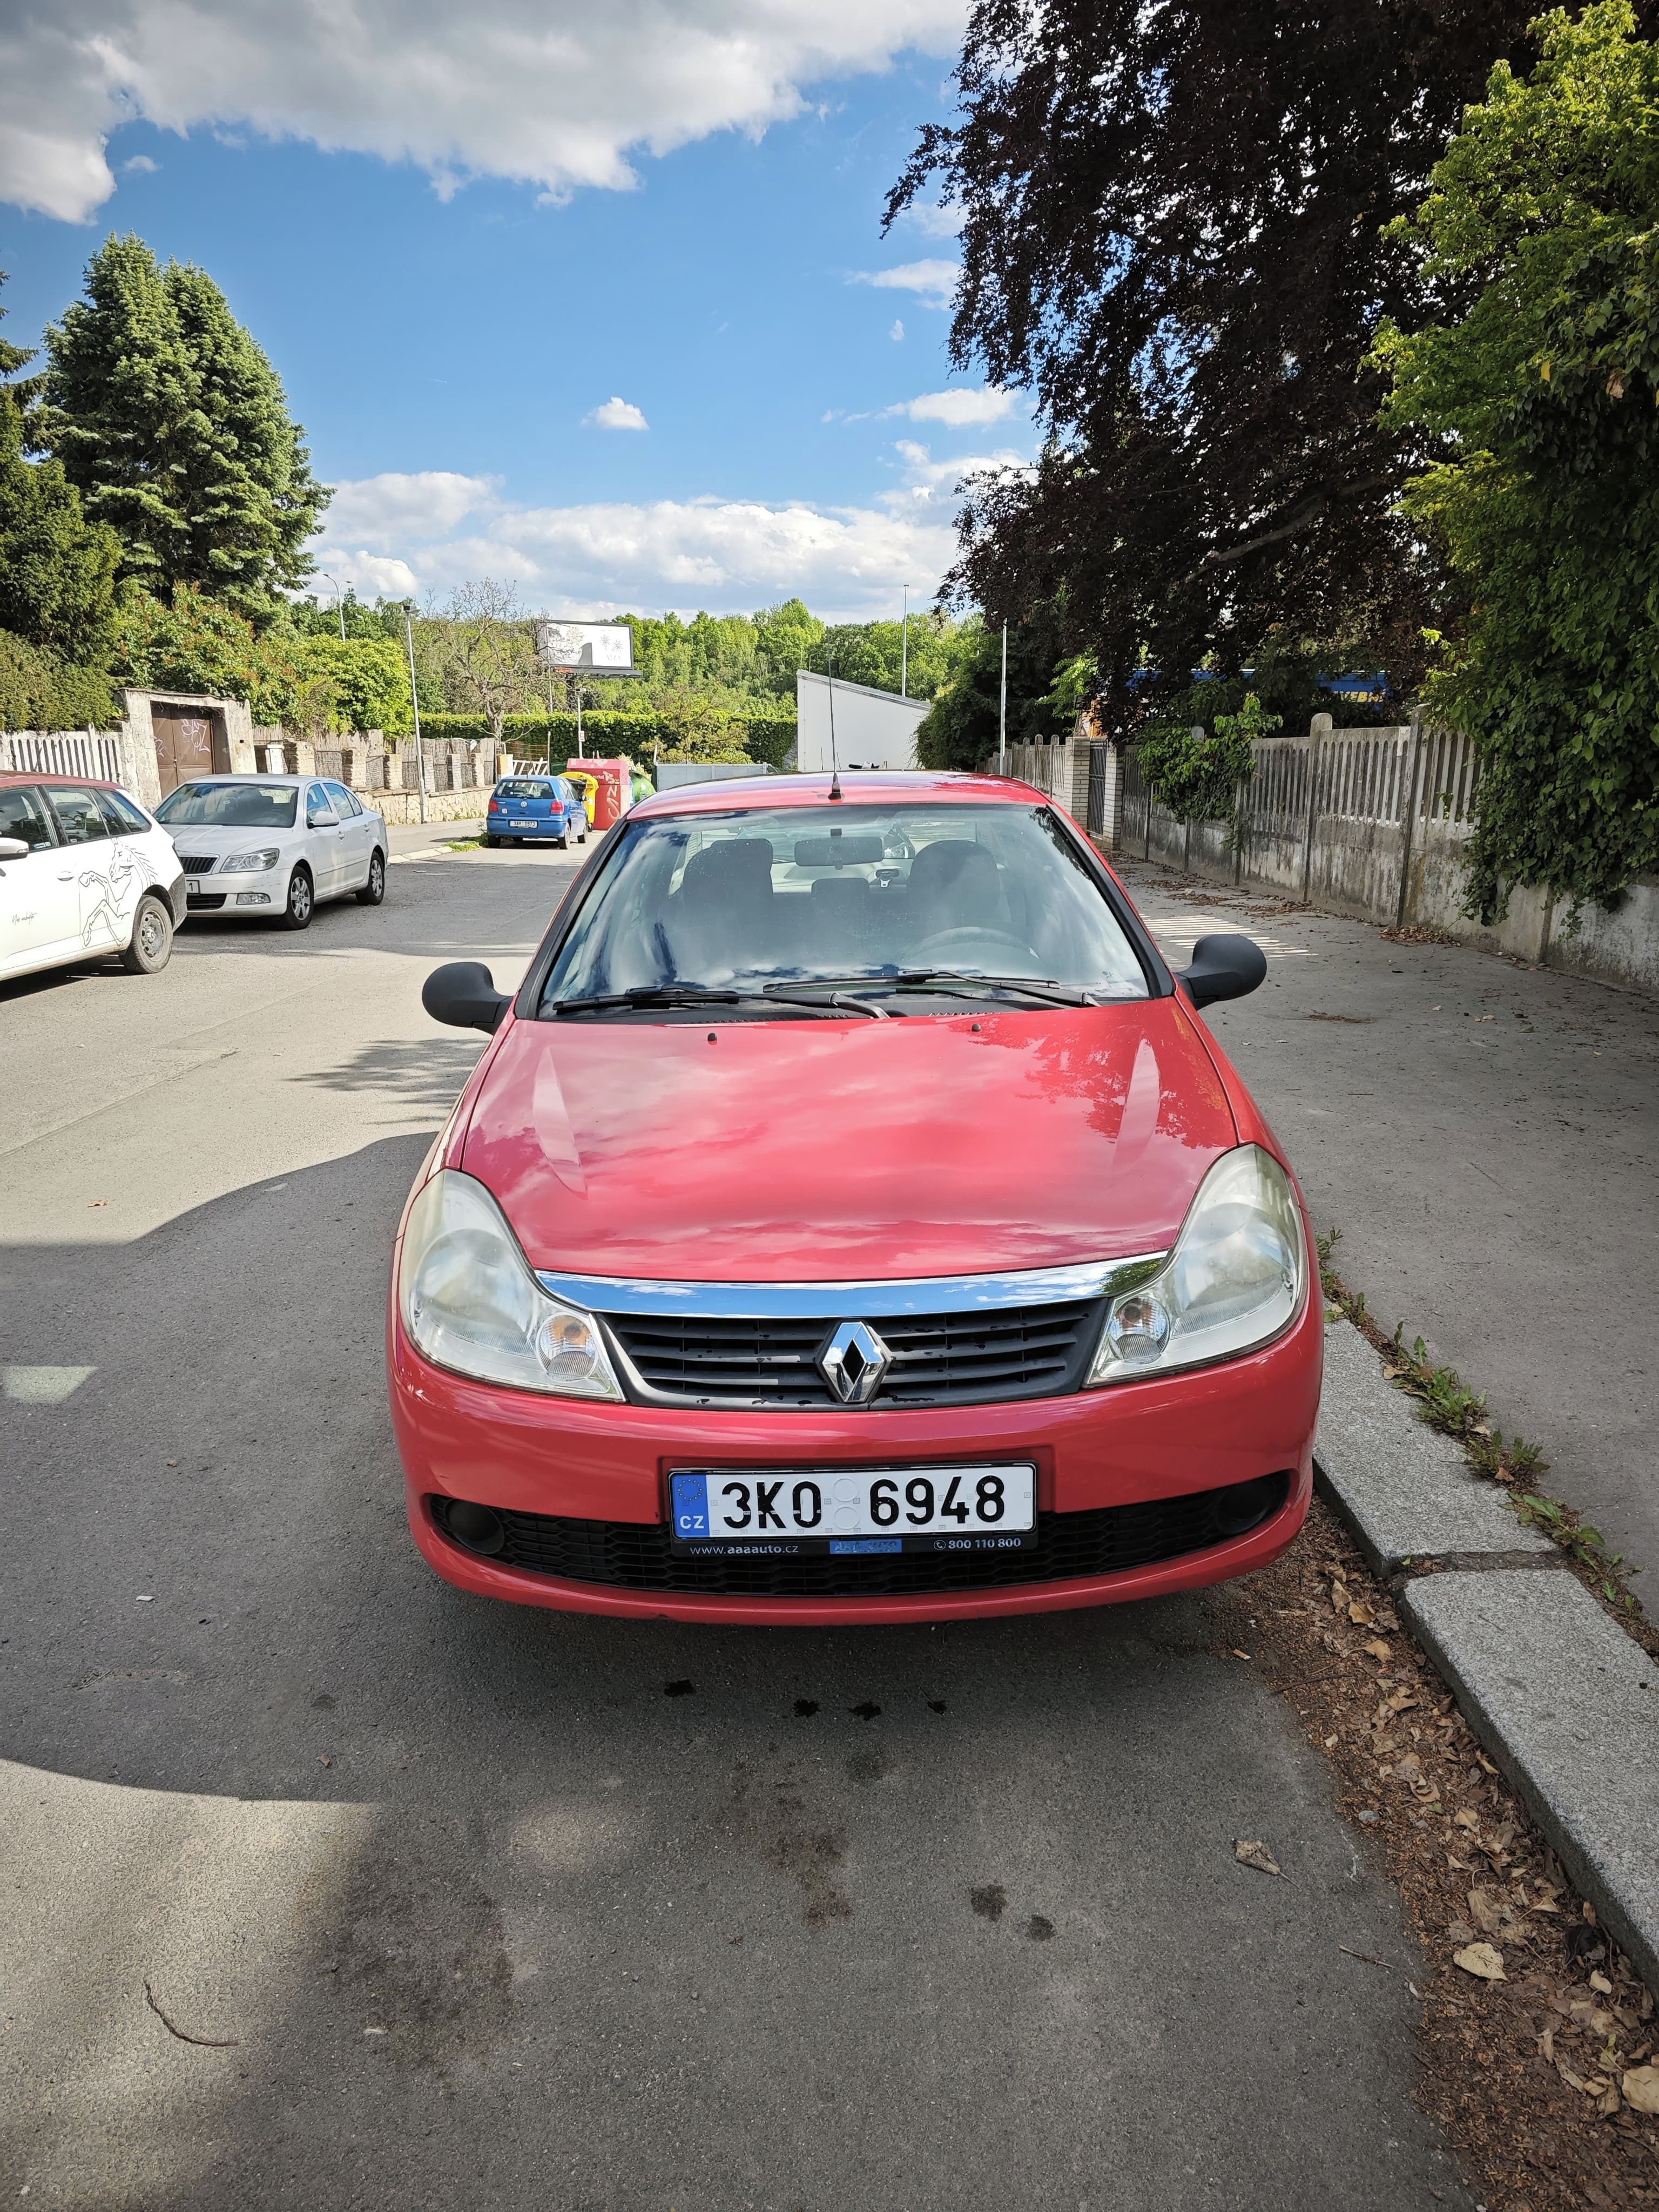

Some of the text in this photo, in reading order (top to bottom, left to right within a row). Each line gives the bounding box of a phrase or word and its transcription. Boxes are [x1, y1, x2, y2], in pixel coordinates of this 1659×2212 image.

[721, 1475, 1005, 1529] 3K0 6948
[679, 1515, 704, 1529] CZ
[690, 1545, 799, 1554] www.aaaauto.cz
[948, 1537, 1021, 1549] 800 110 800
